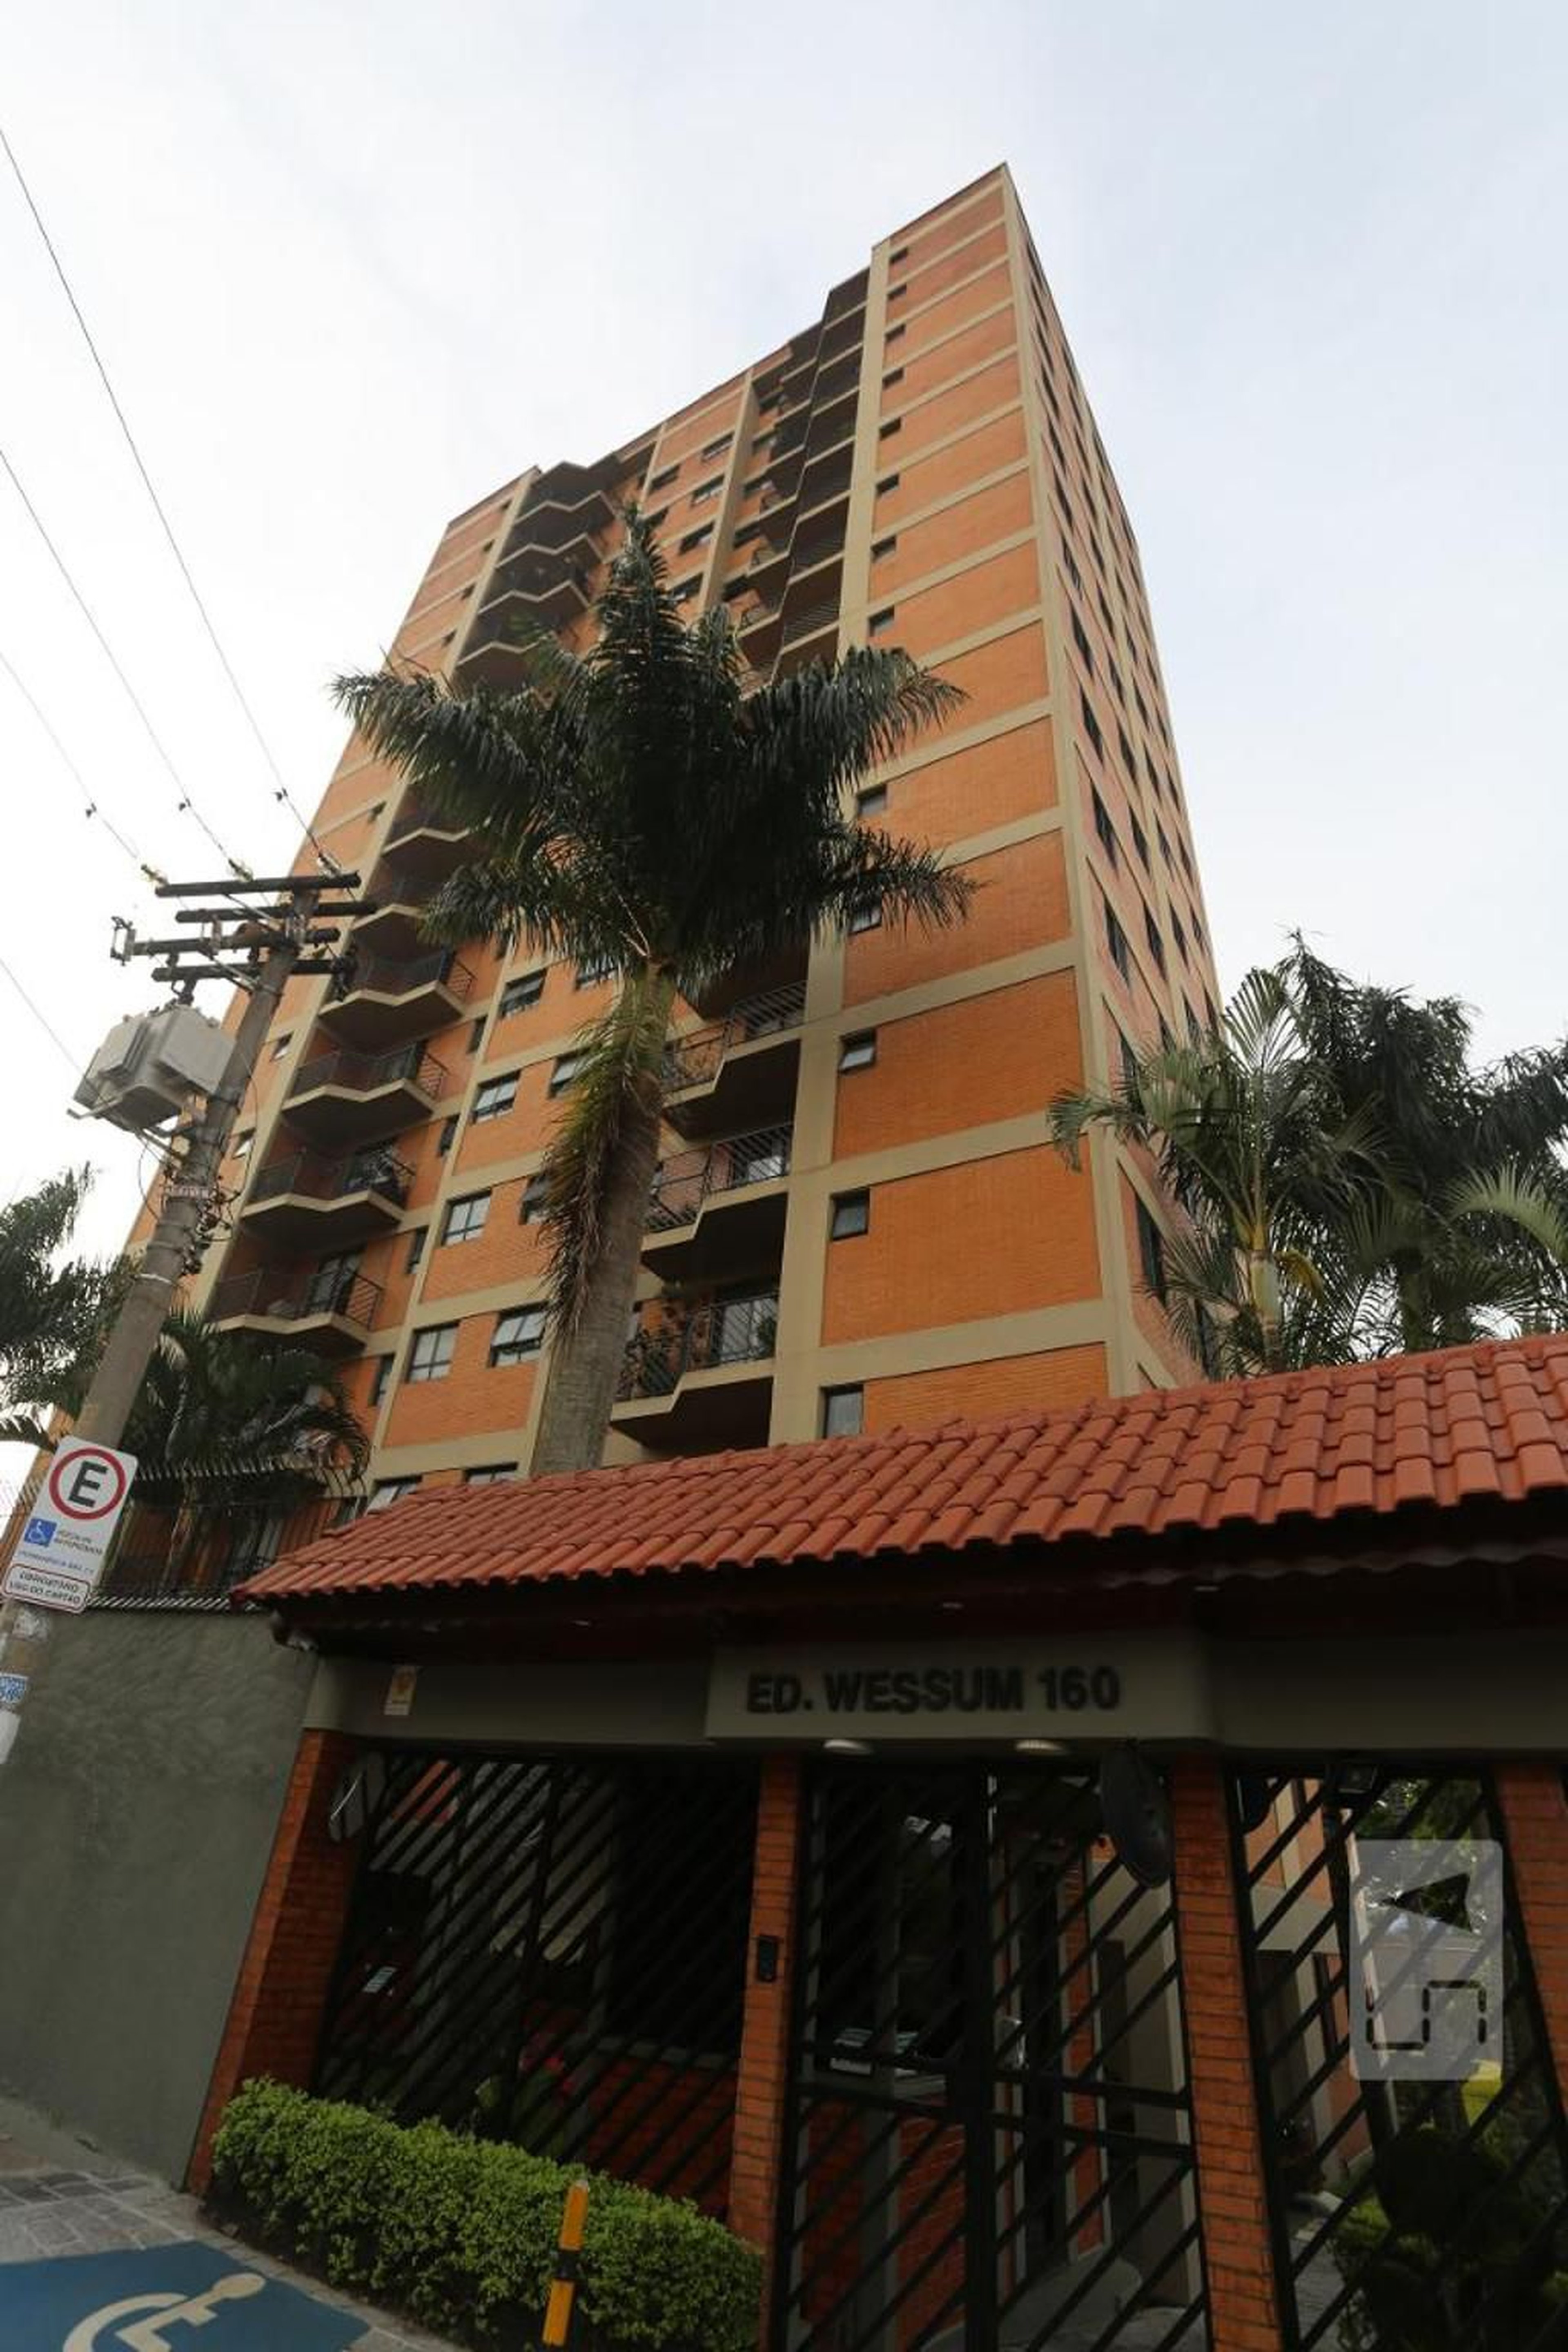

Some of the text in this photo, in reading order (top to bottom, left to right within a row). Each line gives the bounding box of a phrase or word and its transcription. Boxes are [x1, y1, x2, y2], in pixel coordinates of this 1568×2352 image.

[68, 1460, 108, 1508] E
[746, 1666, 1121, 1713] ED. WESSUM 160
